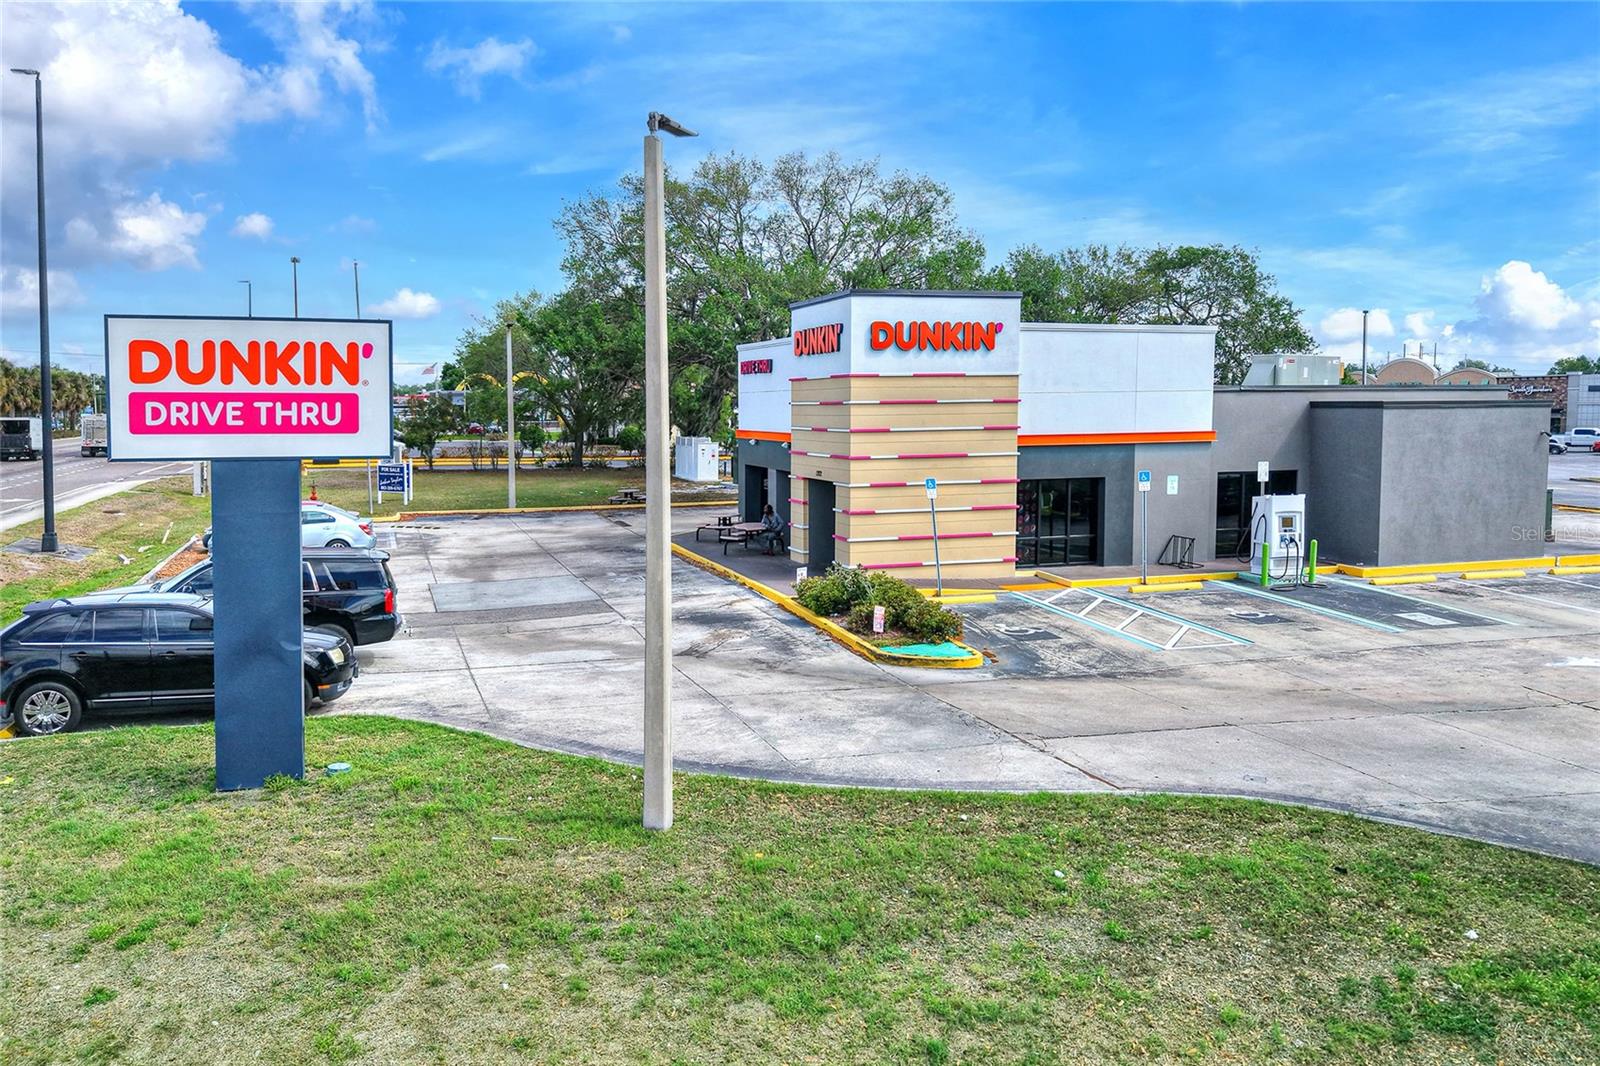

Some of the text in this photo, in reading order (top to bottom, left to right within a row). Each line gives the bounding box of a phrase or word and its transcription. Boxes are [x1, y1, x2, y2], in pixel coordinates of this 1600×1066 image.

[793, 323, 843, 357] DUNKIN'
[870, 321, 1004, 351] DUNKIN'
[128, 339, 374, 386] DUNKIN'
[144, 401, 342, 427] DRIVE THRU
